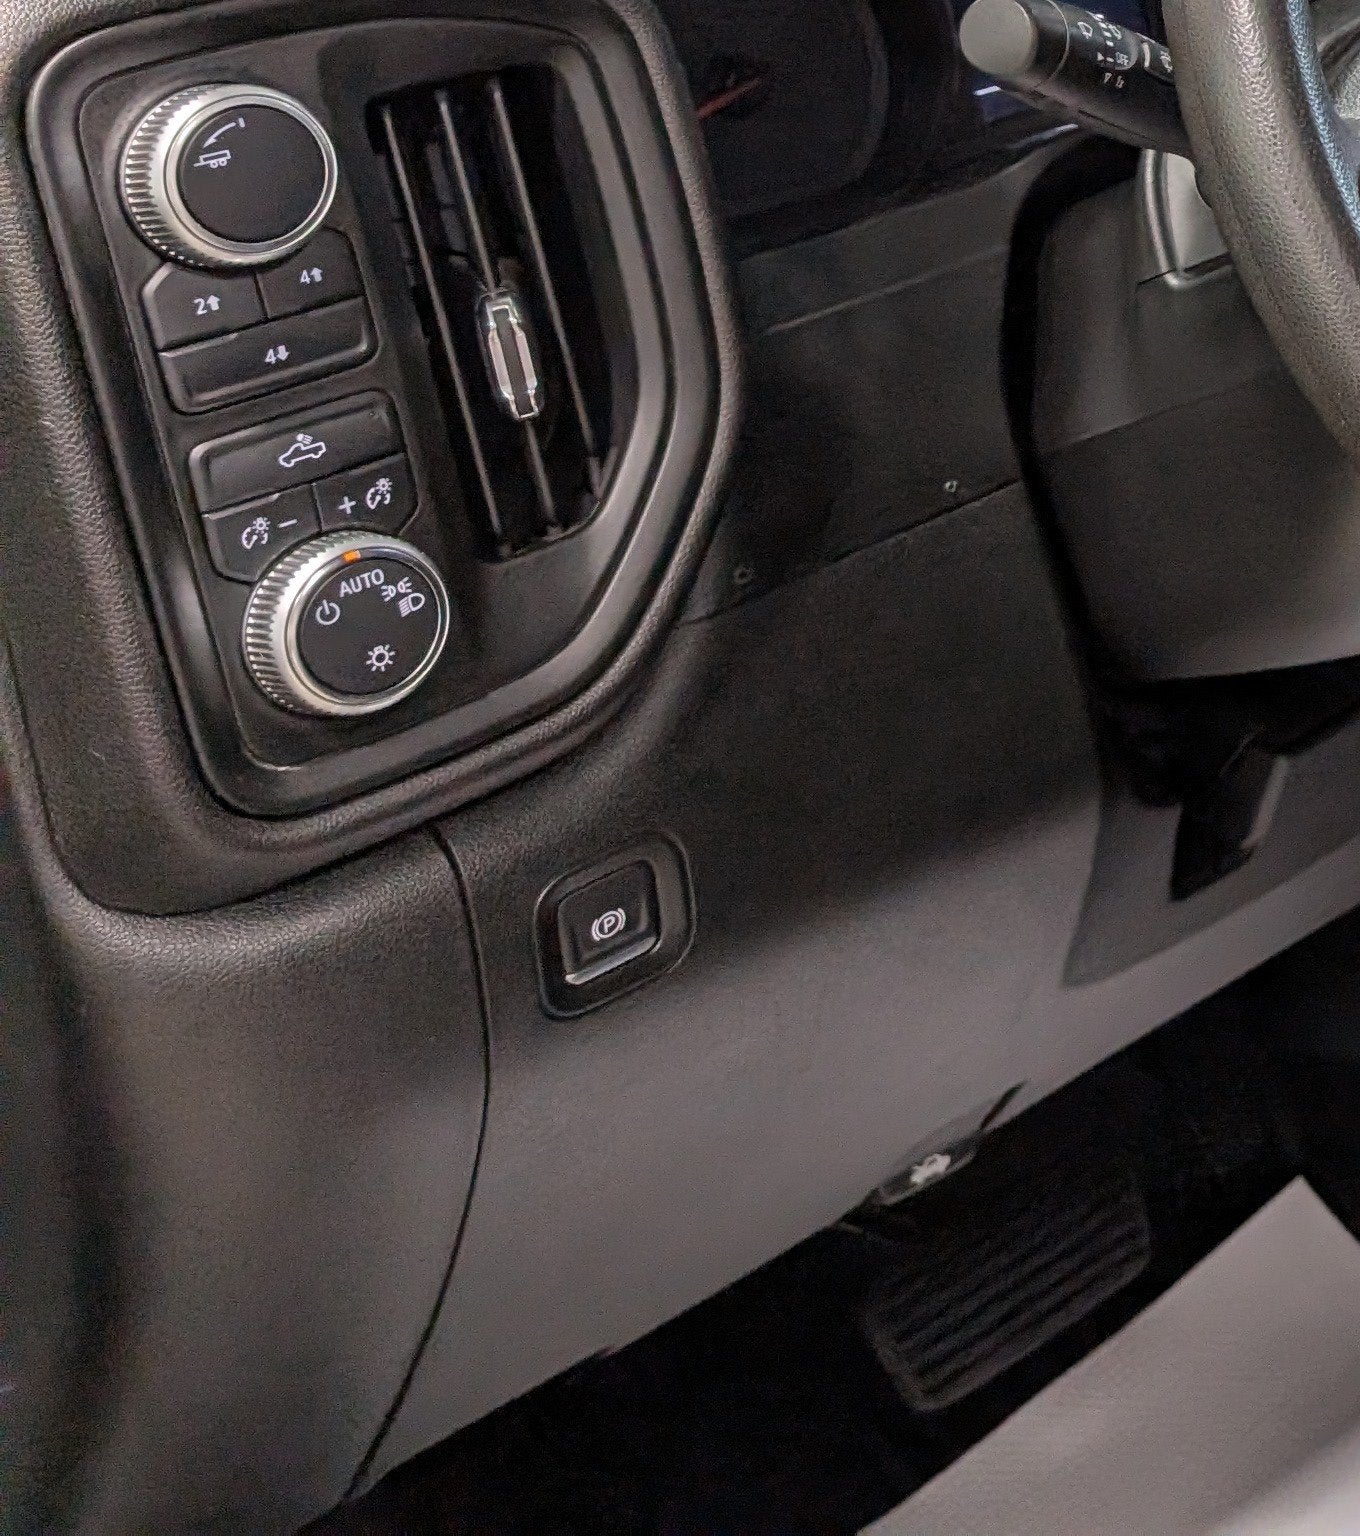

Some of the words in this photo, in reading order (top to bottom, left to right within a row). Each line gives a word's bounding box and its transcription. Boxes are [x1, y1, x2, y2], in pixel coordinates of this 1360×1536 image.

[300, 269, 311, 285] 4
[194, 297, 207, 315] 2
[264, 348, 277, 365] 4
[340, 568, 384, 598] AUTO
